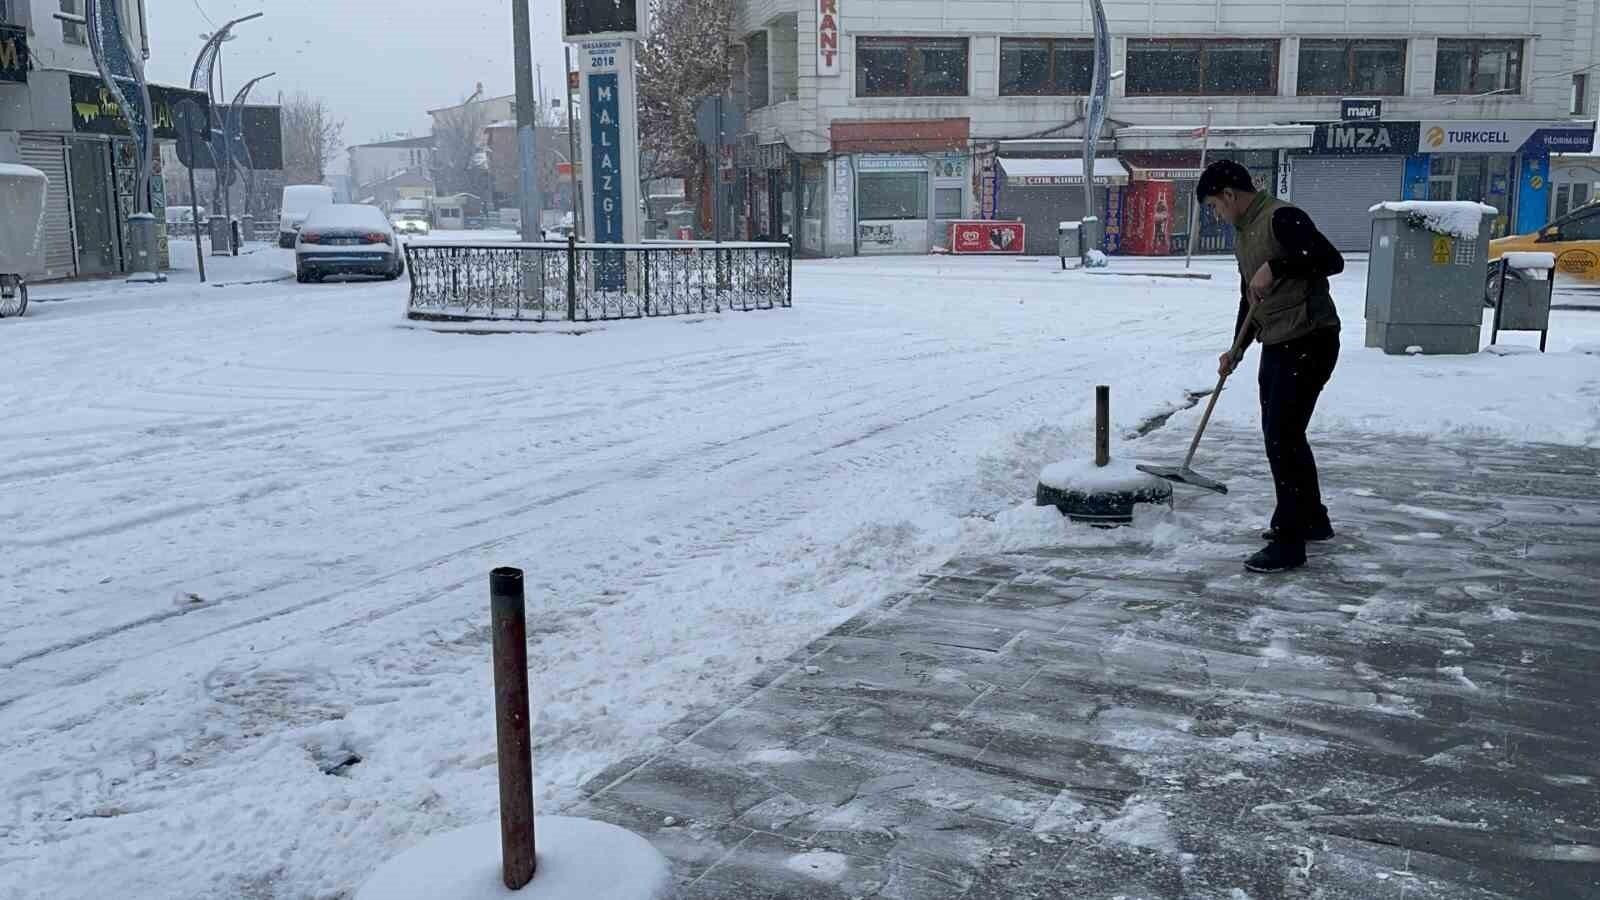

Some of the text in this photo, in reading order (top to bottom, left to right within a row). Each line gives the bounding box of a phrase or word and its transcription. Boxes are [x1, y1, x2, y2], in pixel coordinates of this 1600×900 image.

[592, 56, 614, 67] 2018
[1347, 105, 1377, 117] mavi
[1447, 130, 1510, 145] TURKCELL
